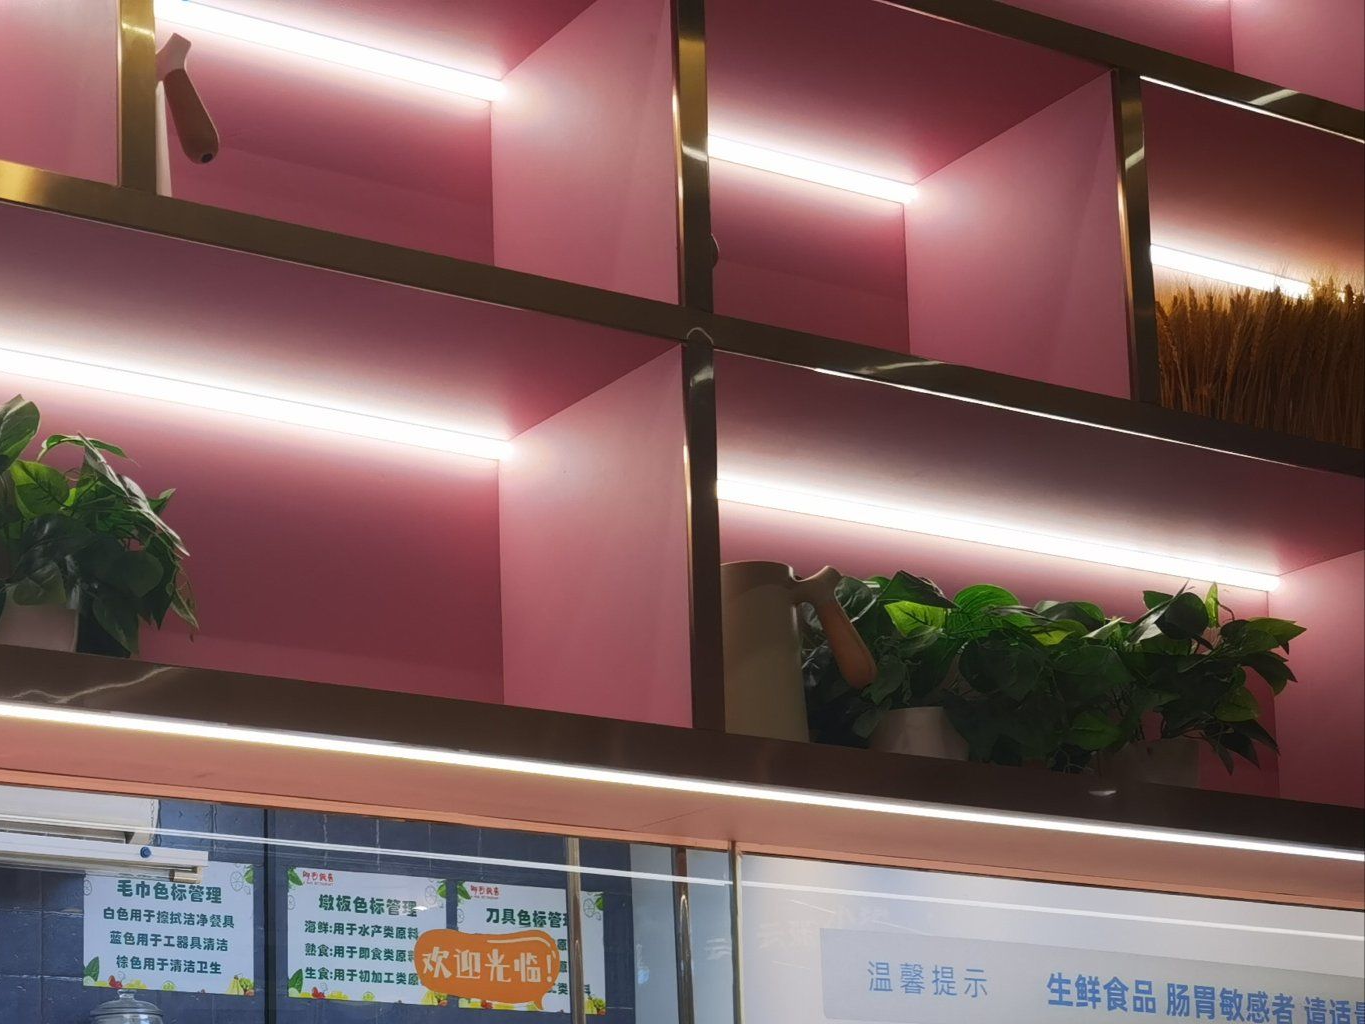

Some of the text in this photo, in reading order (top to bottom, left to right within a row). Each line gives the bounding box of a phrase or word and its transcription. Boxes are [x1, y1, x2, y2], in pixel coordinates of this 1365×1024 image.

[117, 879, 222, 904] 毛巾色标管理
[318, 894, 418, 917] 墩板色标管理
[103, 907, 235, 929] 白色用于擦拭洁净餐具
[109, 930, 229, 952] 蓝色用于工器具清洁
[116, 955, 222, 975] 棕色用于清洁卫生
[421, 945, 553, 983] 欢迎光临!
[867, 960, 989, 998] 温馨提示
[1047, 972, 1157, 1014] 生鲜食品
